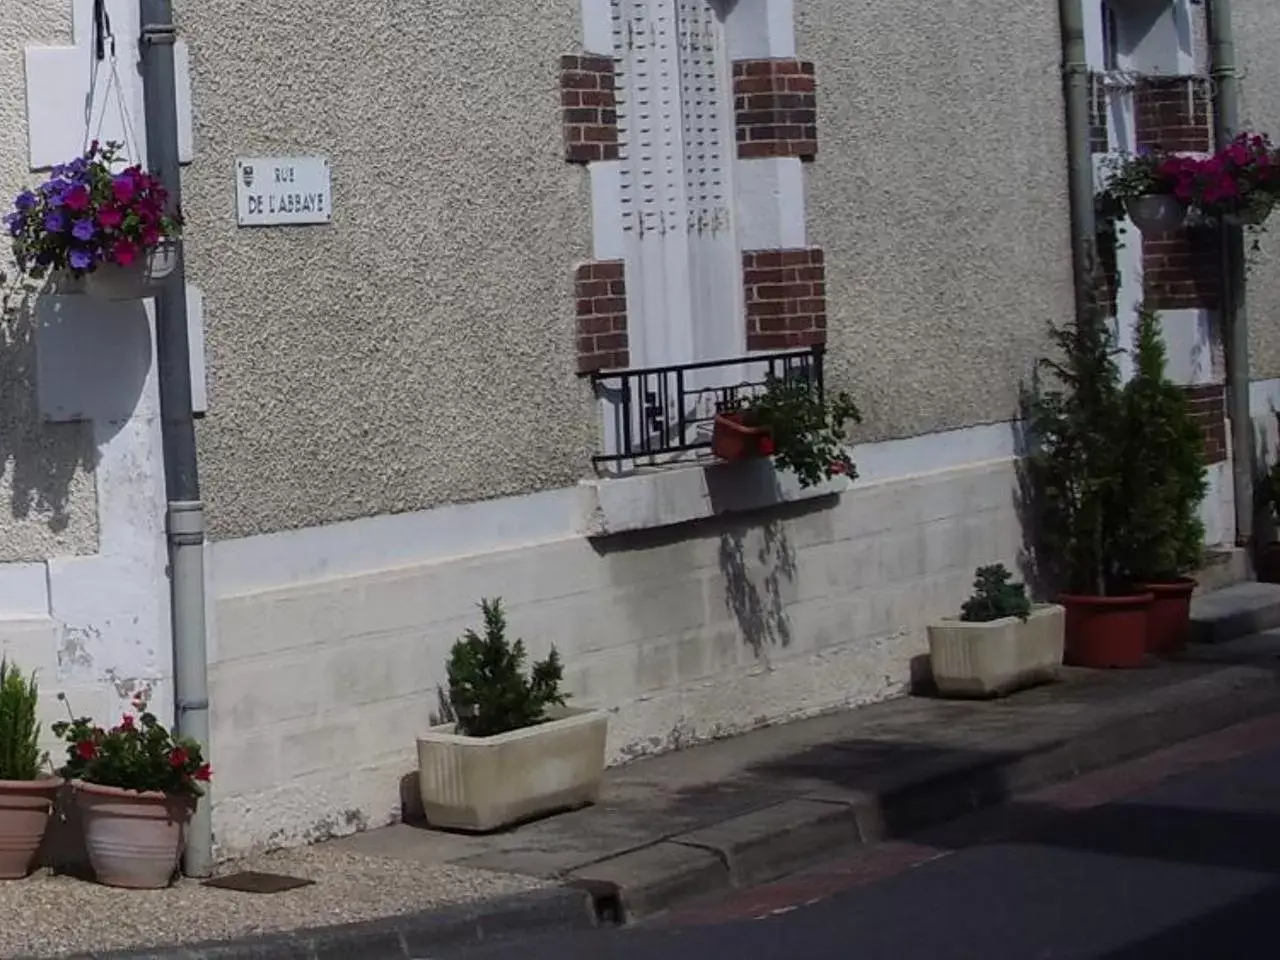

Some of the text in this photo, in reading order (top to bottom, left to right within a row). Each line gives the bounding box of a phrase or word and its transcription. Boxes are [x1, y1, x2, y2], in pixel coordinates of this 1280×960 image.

[274, 167, 295, 183] RUE
[248, 192, 324, 215] DE L'ABBAYE
